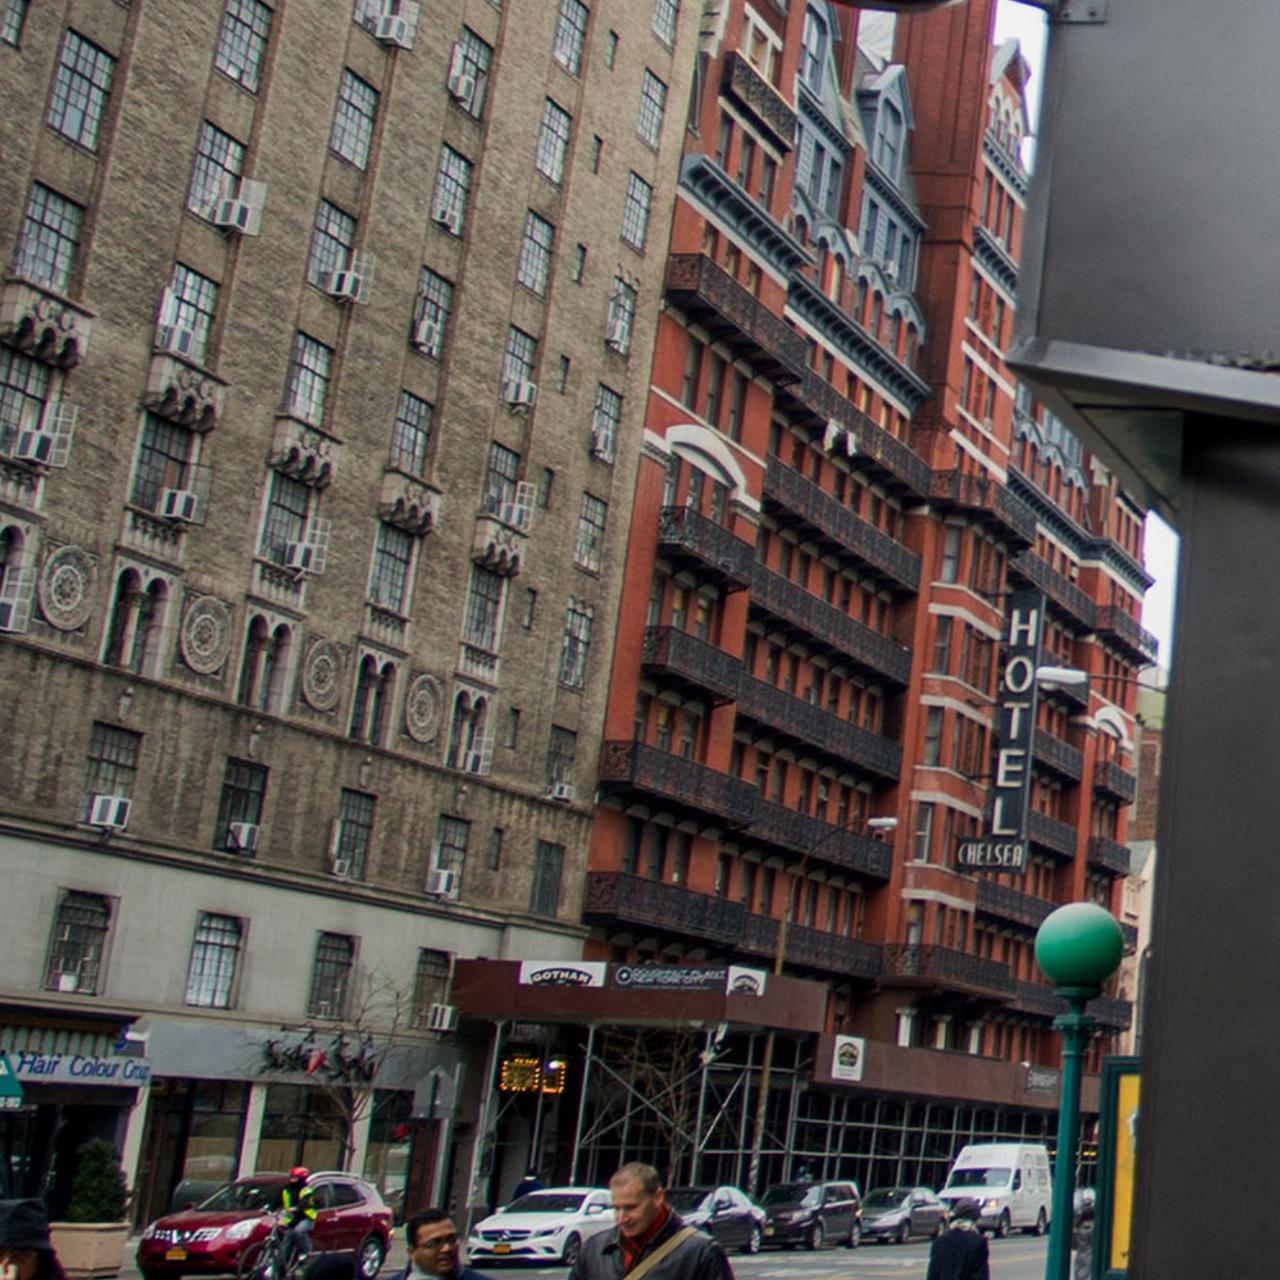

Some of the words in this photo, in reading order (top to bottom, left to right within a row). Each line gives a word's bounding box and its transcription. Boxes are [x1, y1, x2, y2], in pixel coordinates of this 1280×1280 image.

[992, 609, 1038, 836] HOTEL
[958, 842, 1024, 868] CHELSEA
[531, 968, 592, 984] GOTHAM
[16, 1050, 62, 1075] Hair
[69, 1055, 120, 1078] Colour
